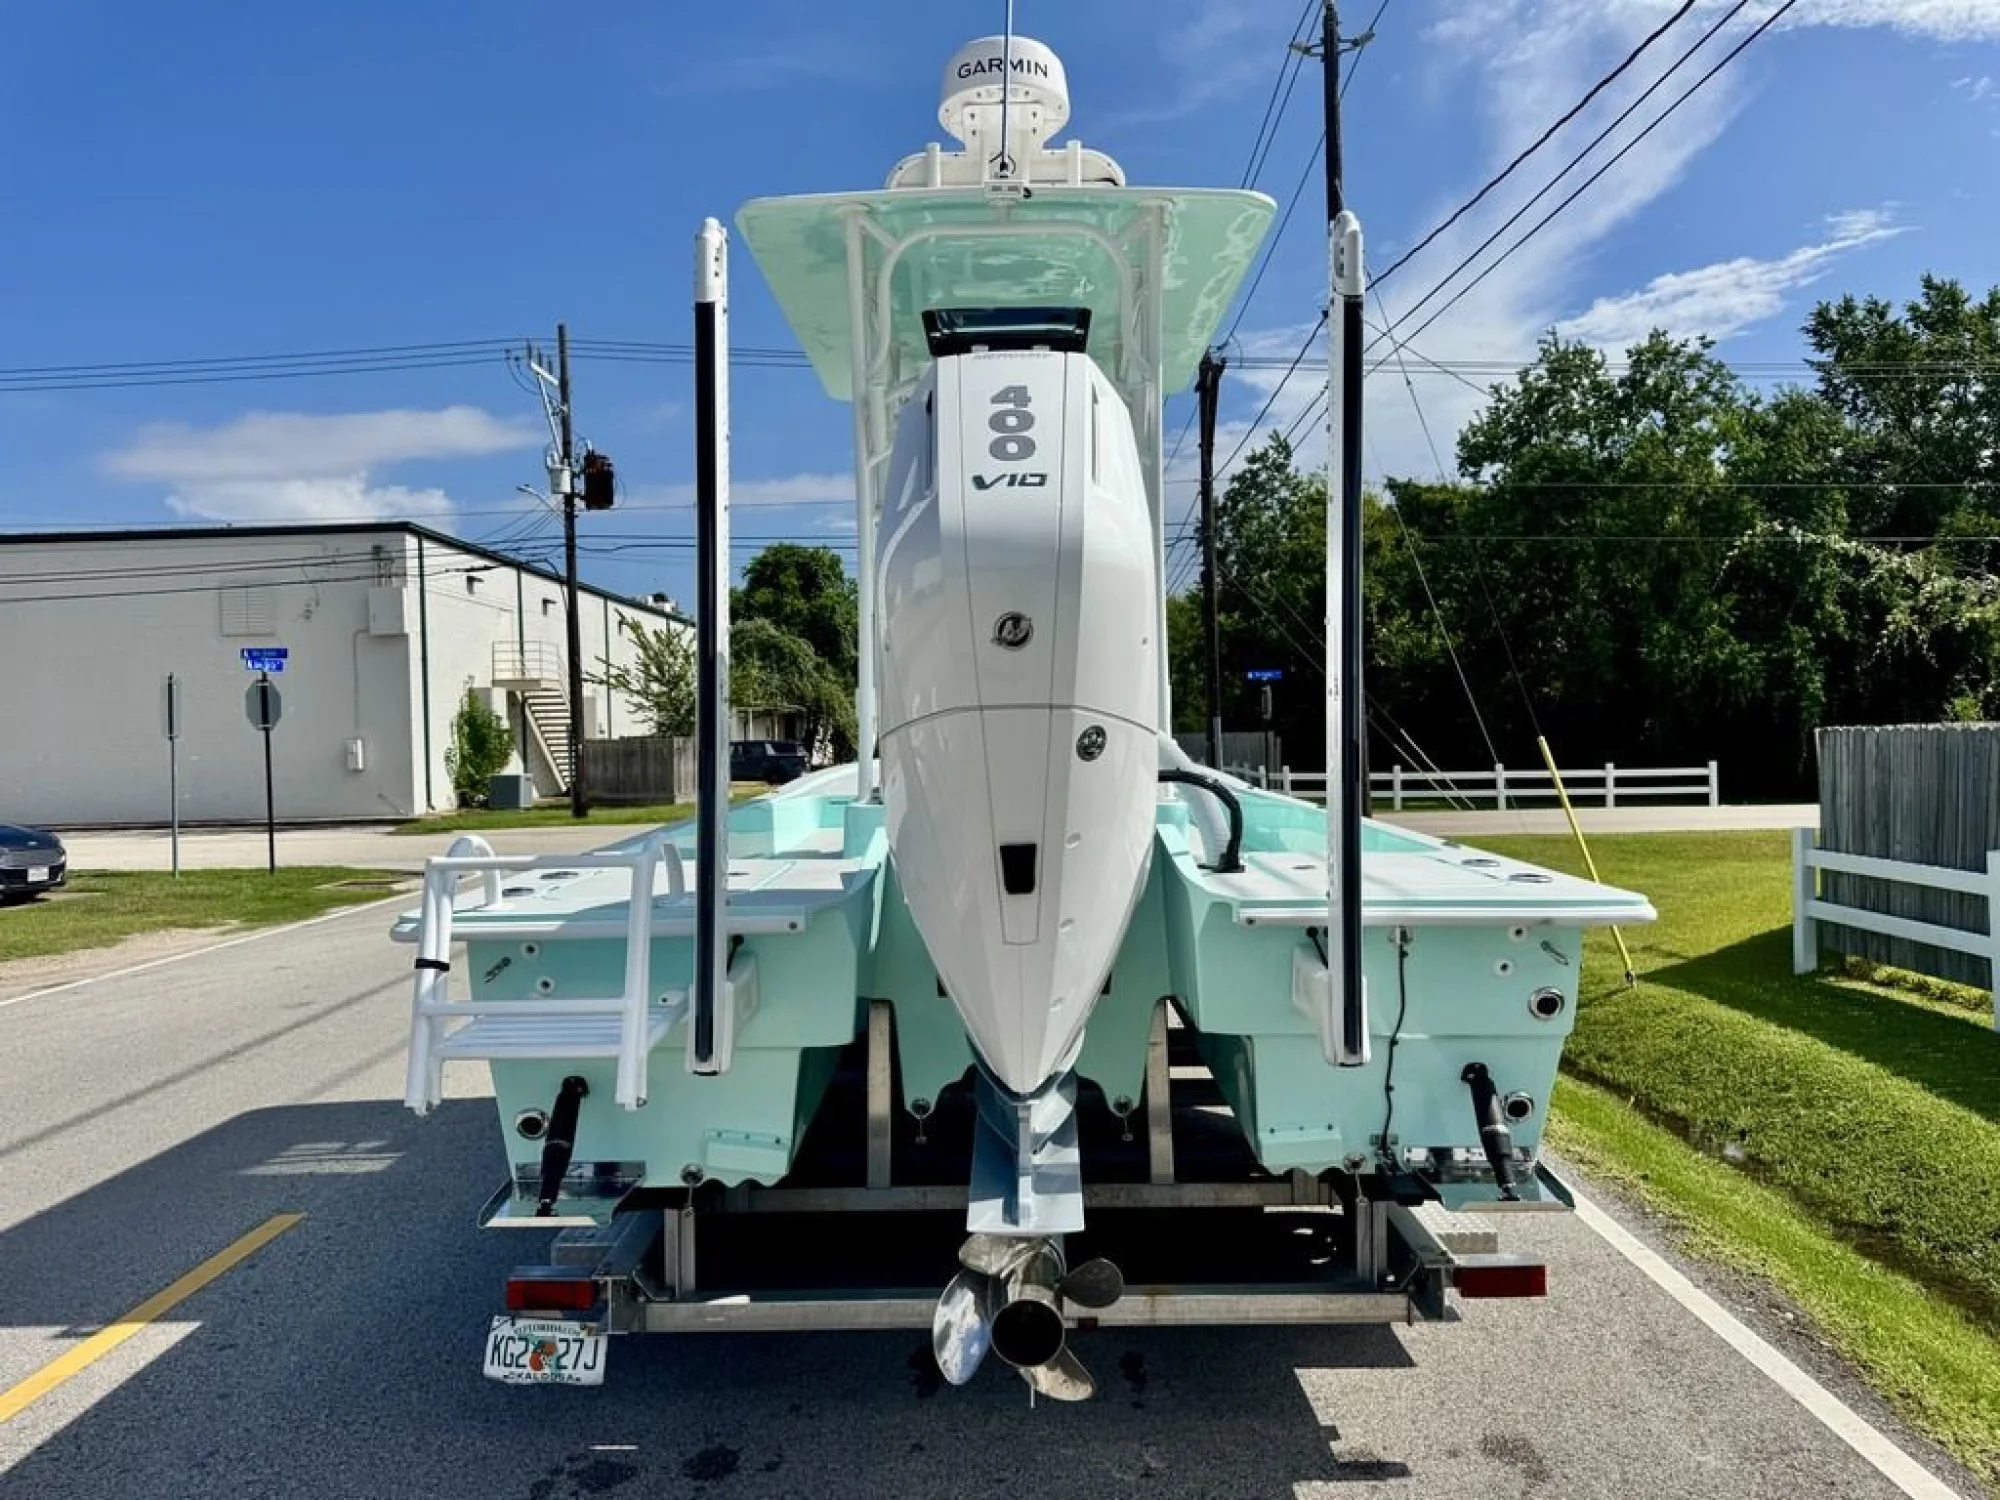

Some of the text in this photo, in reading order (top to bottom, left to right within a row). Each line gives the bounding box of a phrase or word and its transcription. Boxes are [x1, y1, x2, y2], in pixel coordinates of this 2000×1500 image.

[957, 58, 1048, 79] GARMIN
[988, 385, 1036, 461] 400
[489, 1333, 599, 1371] KG2 27J
